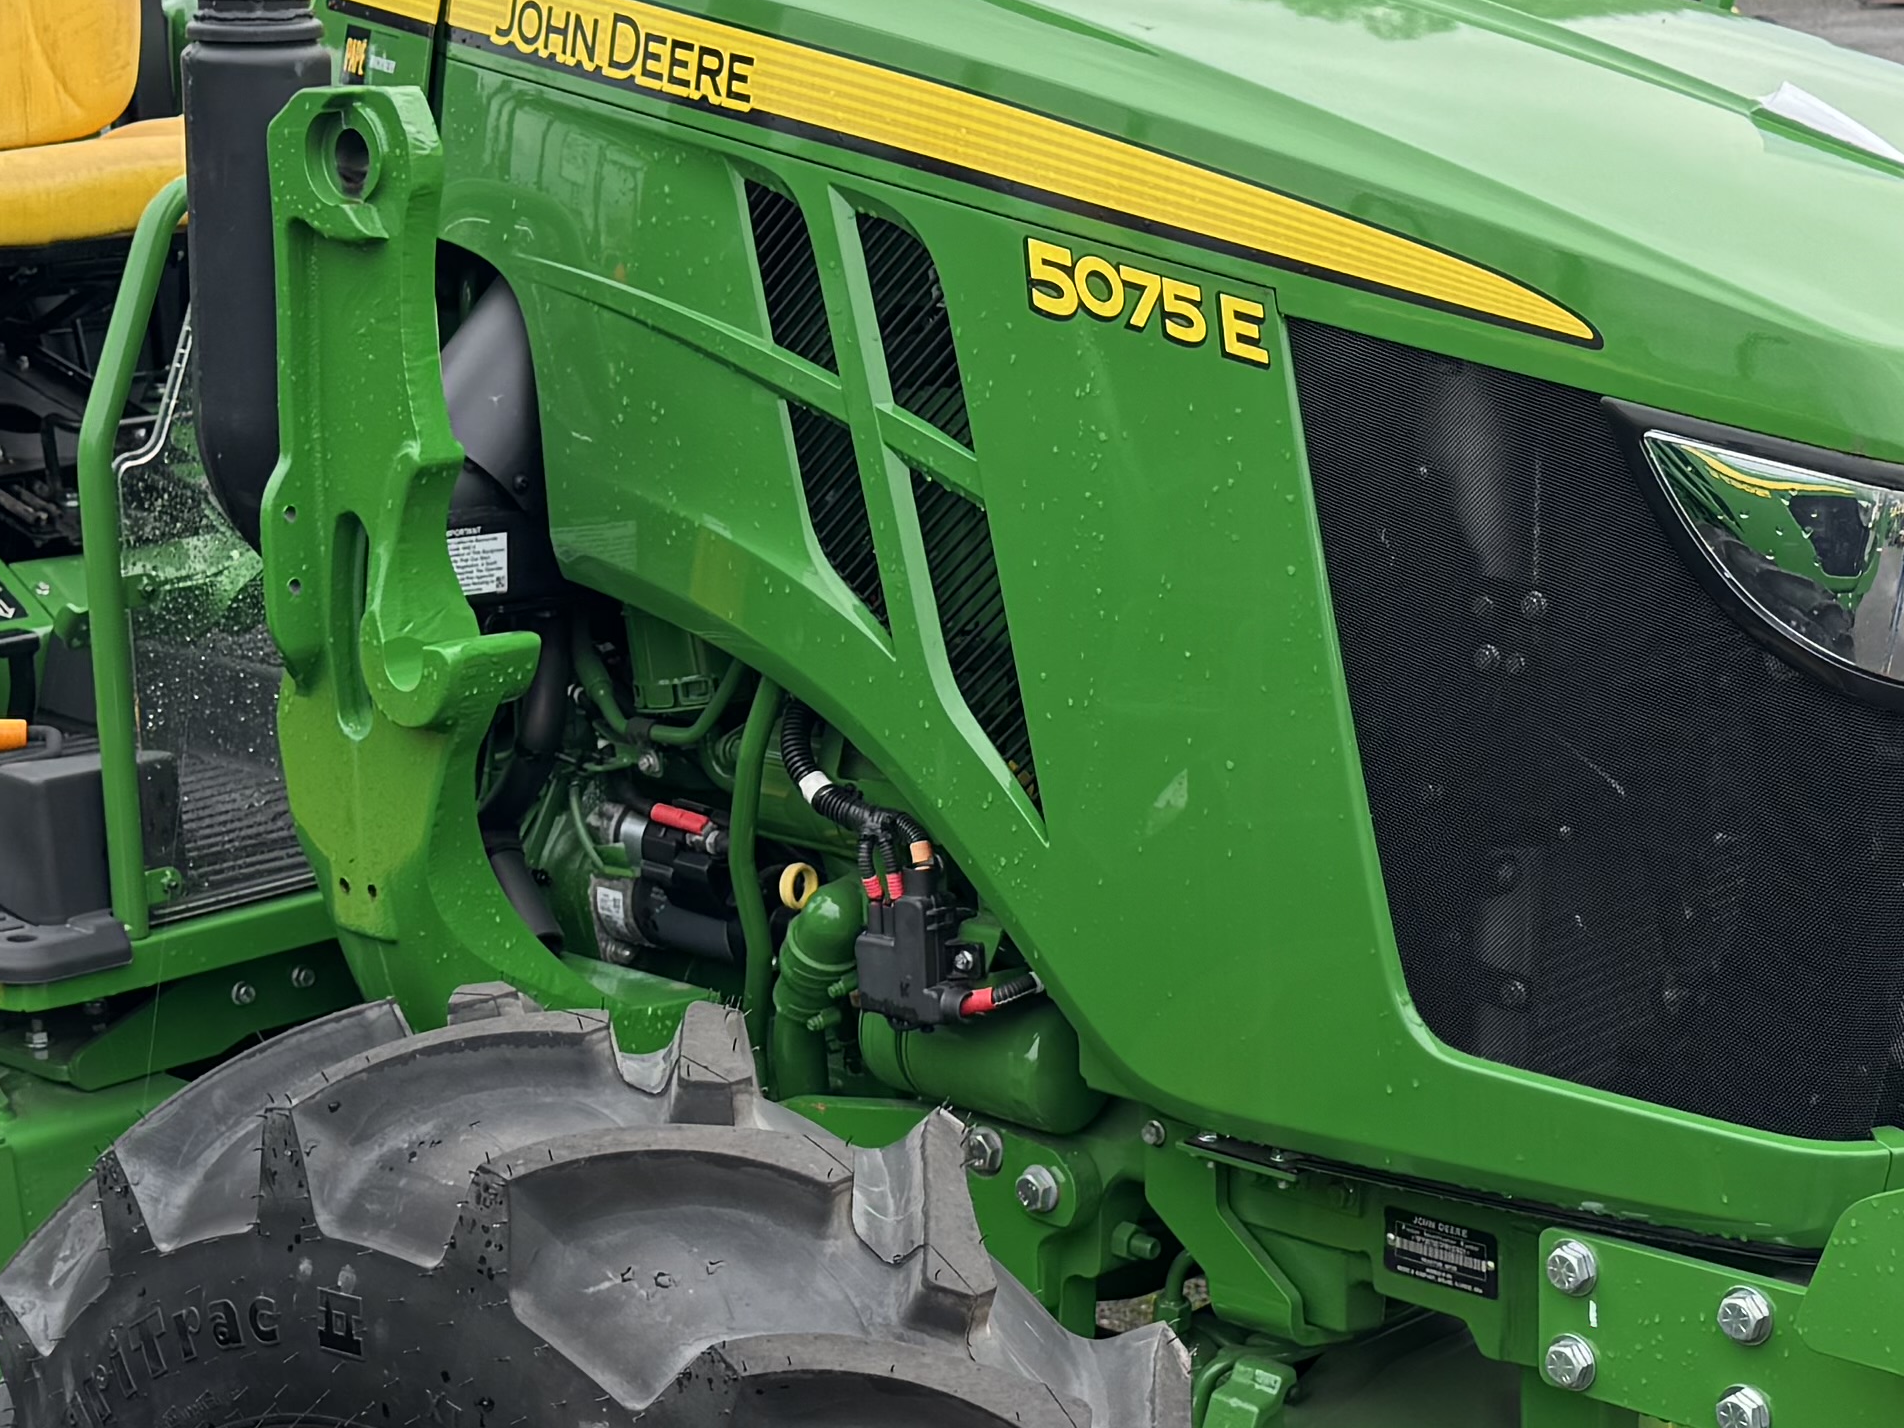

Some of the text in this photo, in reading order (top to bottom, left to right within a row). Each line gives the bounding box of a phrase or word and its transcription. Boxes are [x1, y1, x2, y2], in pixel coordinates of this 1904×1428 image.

[607, 13, 754, 106] DEERE
[1026, 236, 1273, 369] 5075 E
